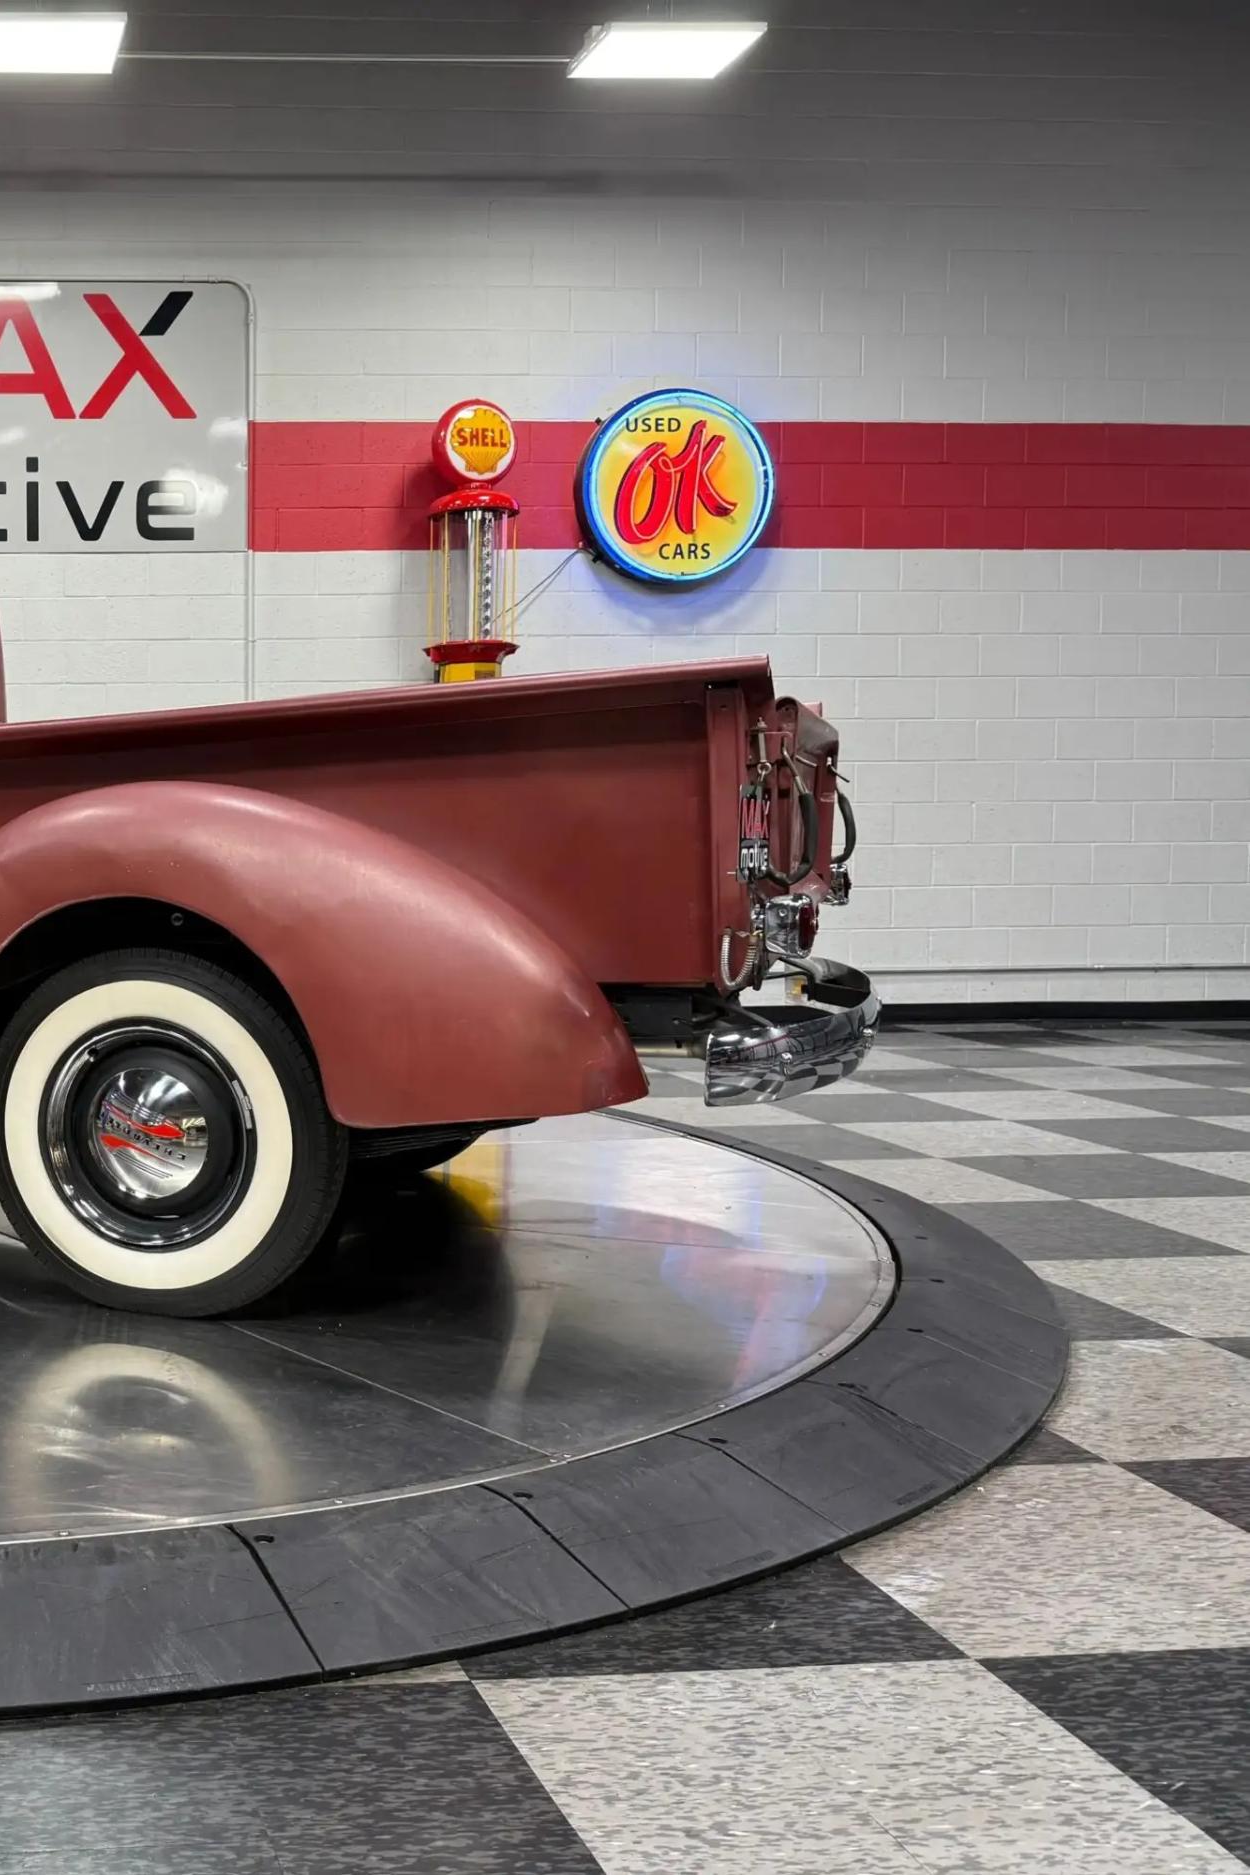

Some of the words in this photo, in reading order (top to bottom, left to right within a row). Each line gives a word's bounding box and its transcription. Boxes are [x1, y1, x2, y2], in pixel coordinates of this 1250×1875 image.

[625, 417, 682, 433] USED
[456, 427, 507, 448] SHELL
[615, 421, 737, 543] OK
[658, 543, 711, 561] CARS
[742, 799, 770, 838] MAX
